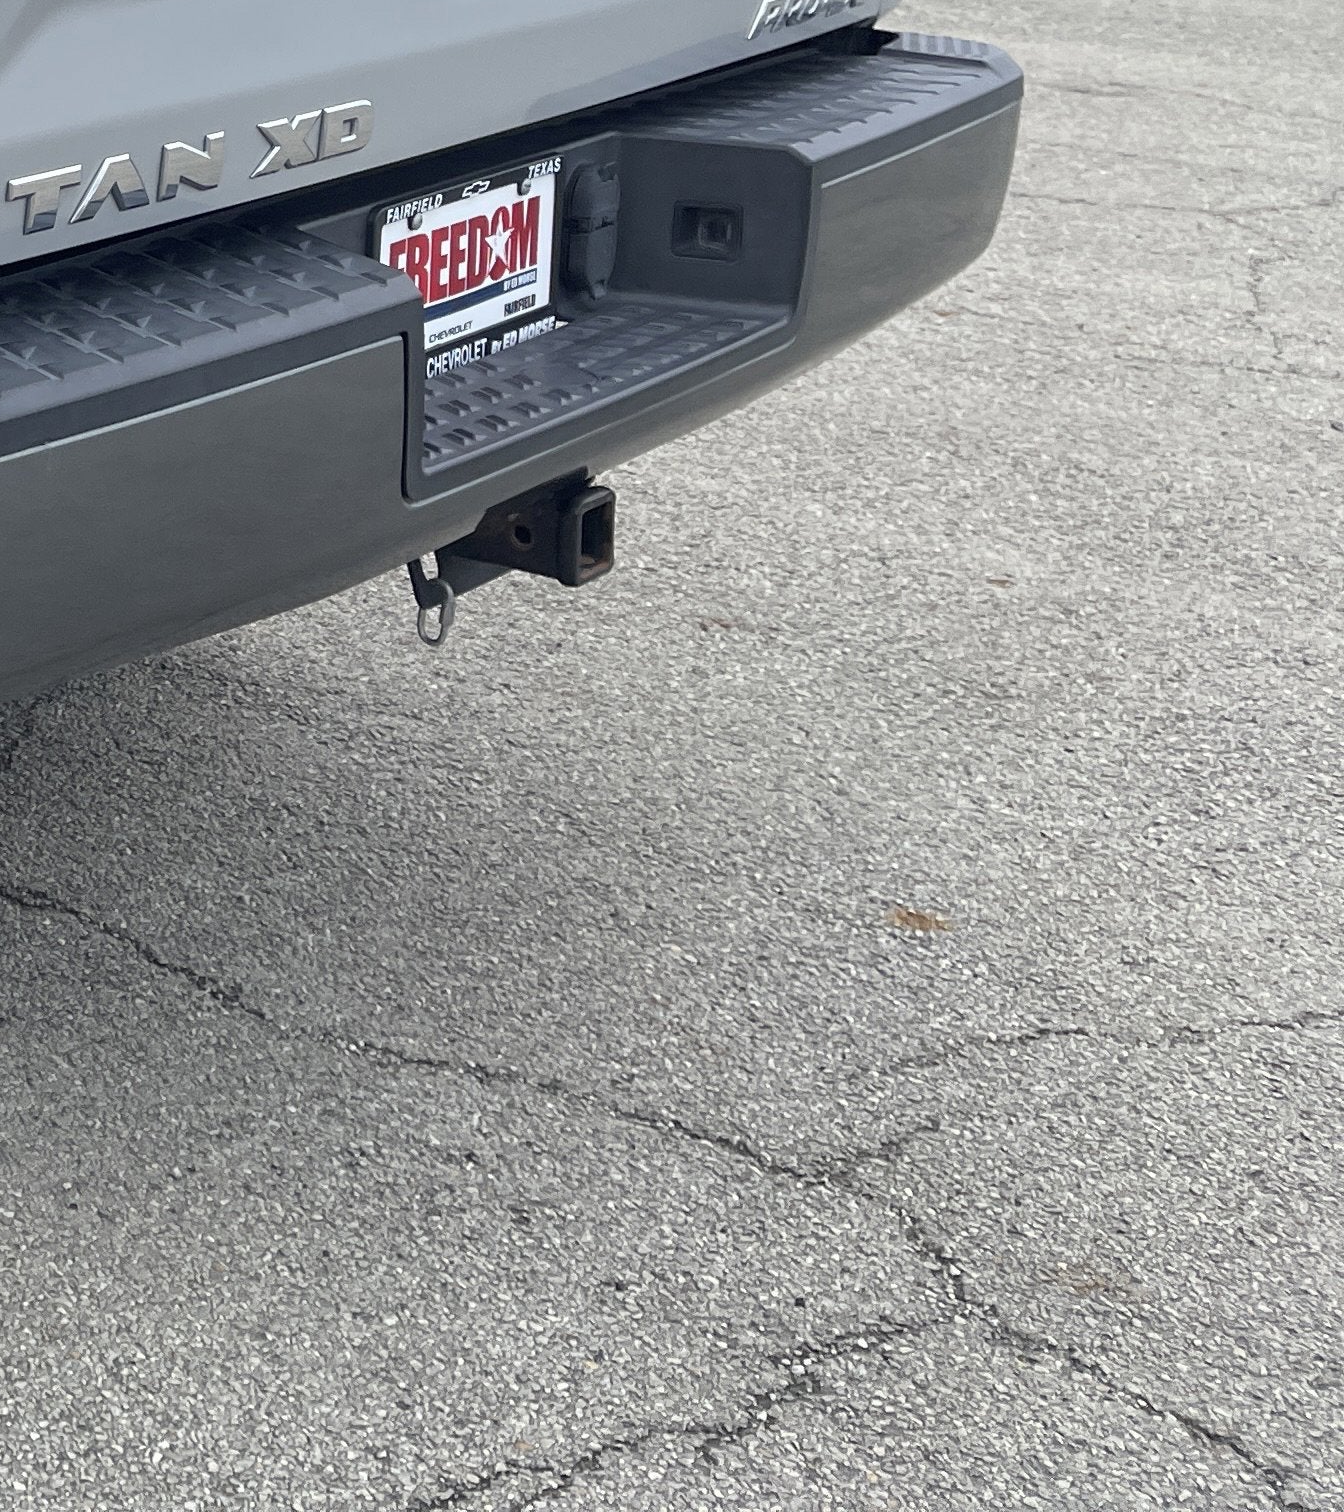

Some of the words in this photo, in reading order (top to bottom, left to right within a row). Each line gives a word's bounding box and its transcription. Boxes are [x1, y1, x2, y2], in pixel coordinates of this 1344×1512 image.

[250, 99, 374, 179] XD
[386, 194, 444, 224] FAIRFIELD
[528, 157, 562, 180] TEXAS
[426, 338, 488, 379] CHEVROLET
[503, 330, 518, 350] ED
[518, 316, 556, 344] MORSE
[428, 320, 473, 343] CHEVROLET
